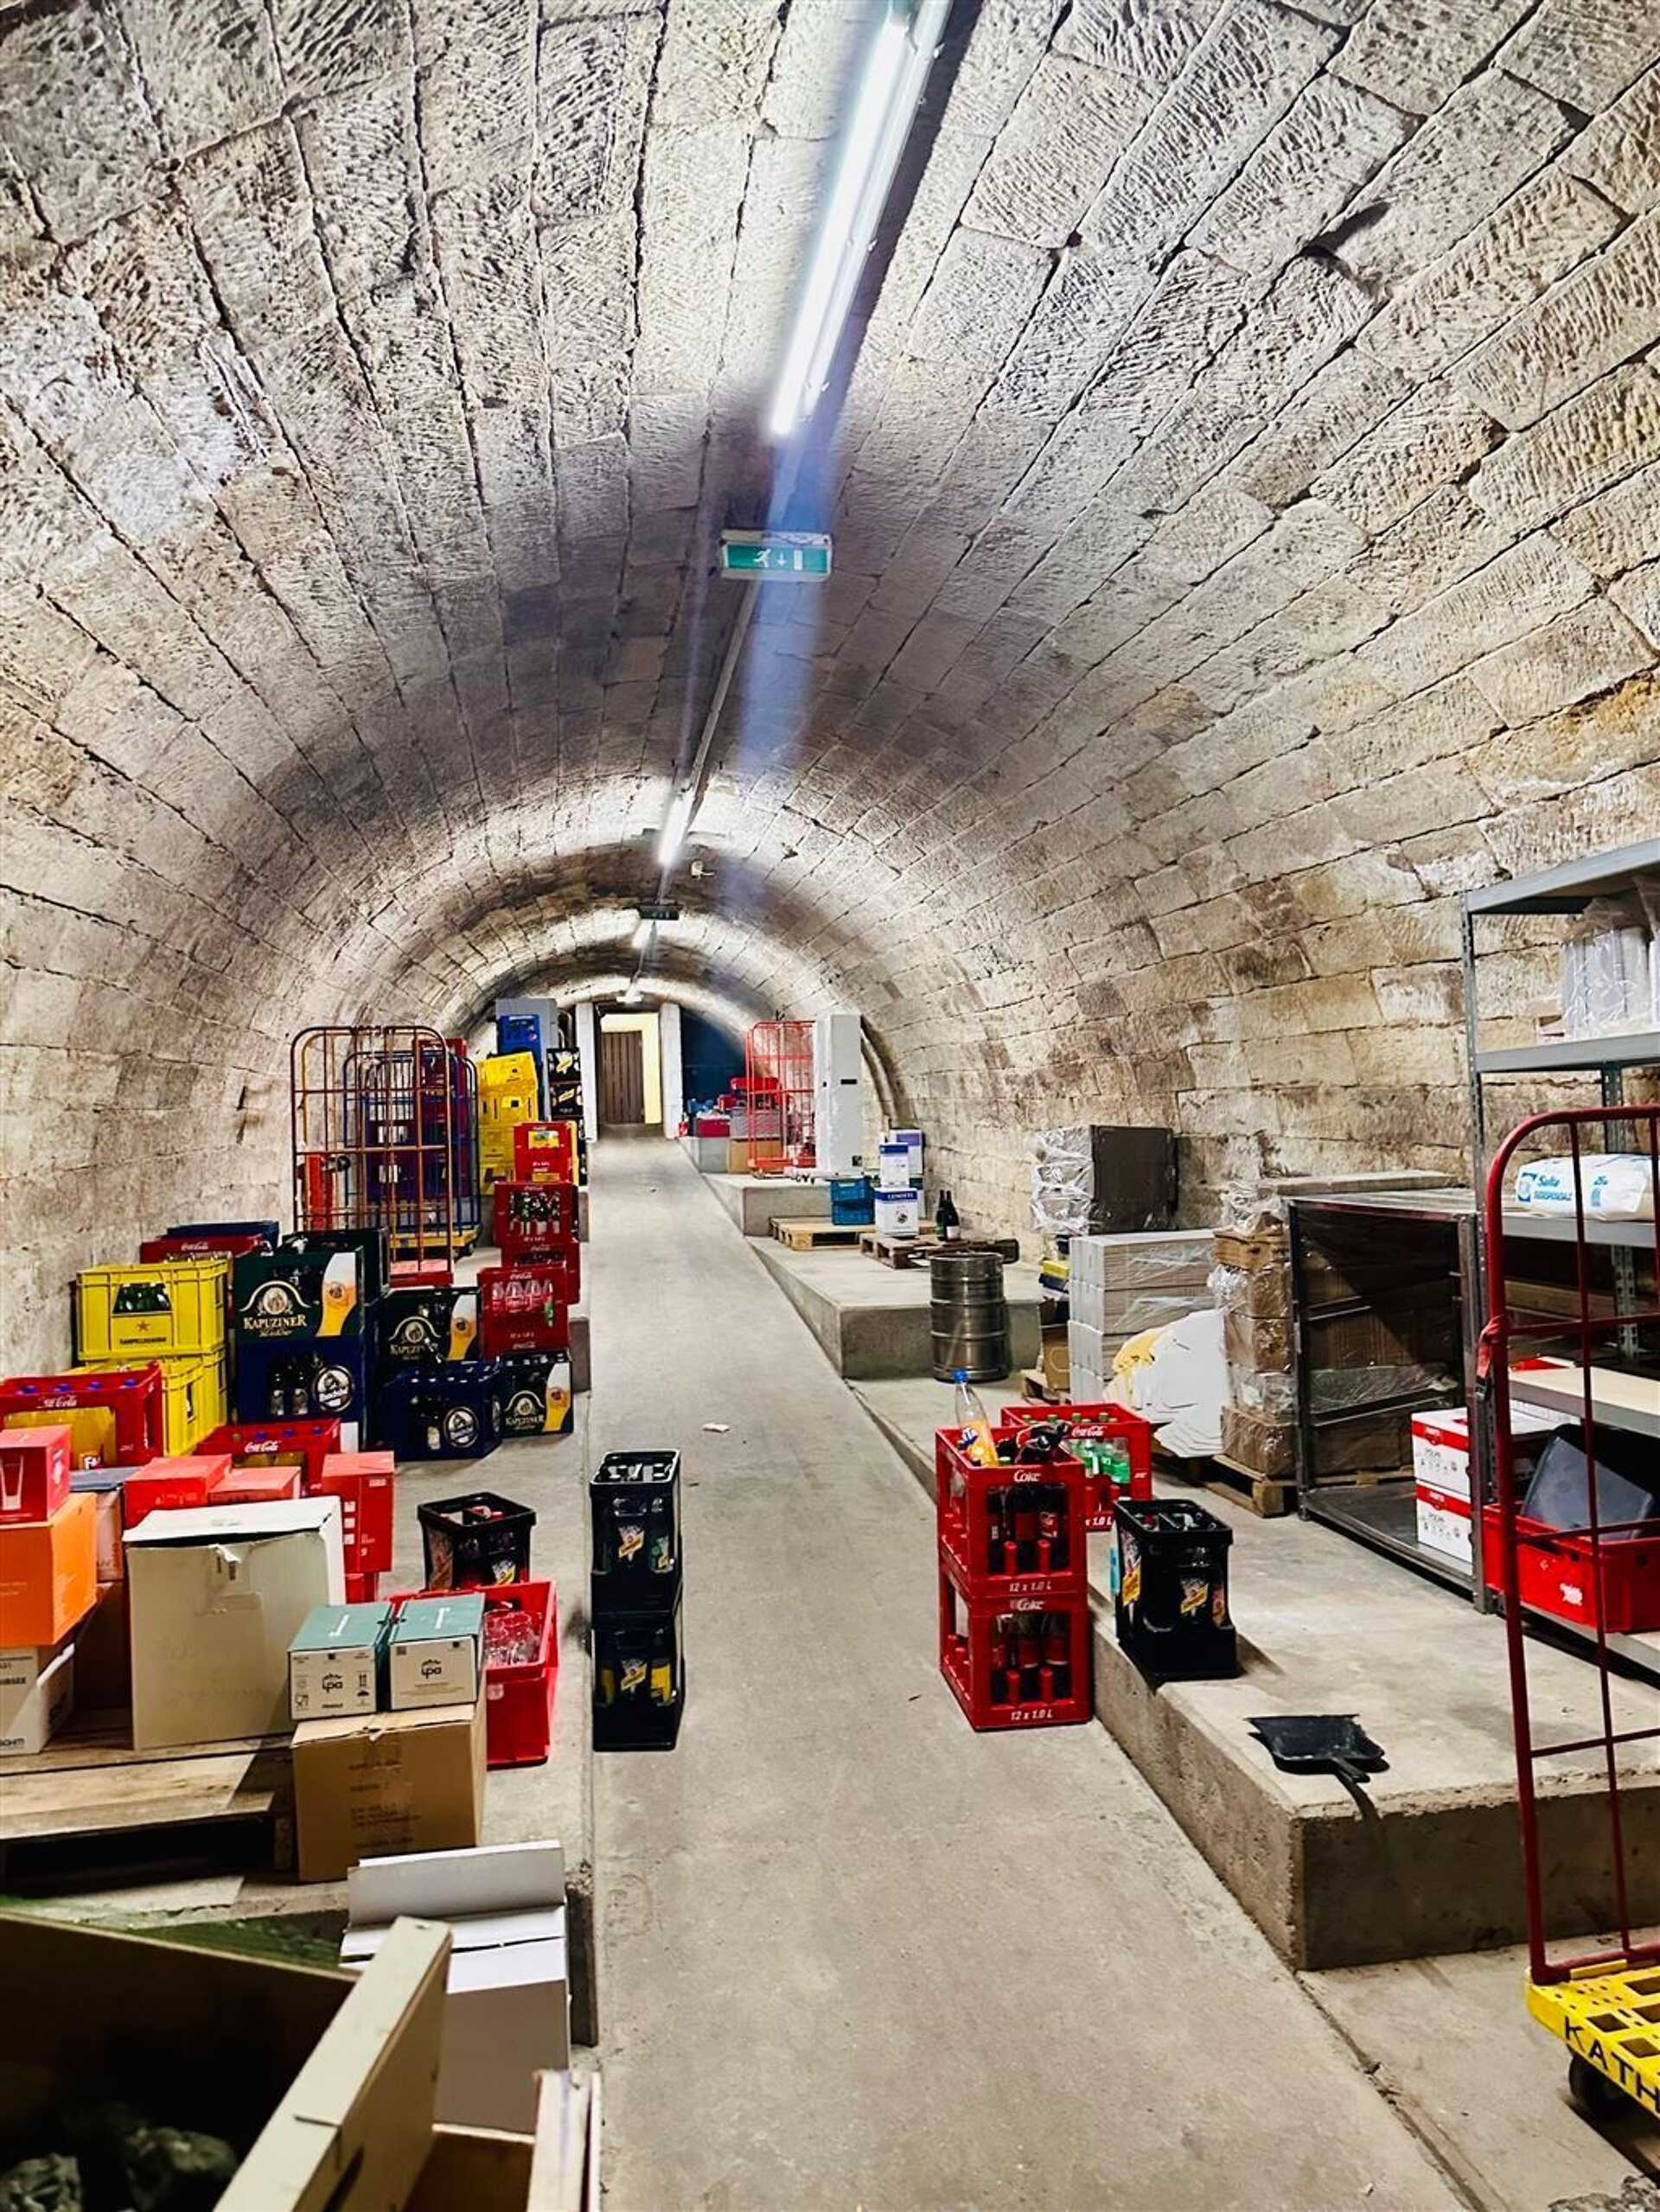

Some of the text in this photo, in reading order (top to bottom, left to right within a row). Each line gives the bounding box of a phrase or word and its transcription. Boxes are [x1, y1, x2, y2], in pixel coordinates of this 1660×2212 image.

[244, 1314, 308, 1329] KAPUZINER
[1013, 1469, 1042, 1482] Coke
[1009, 1583, 1020, 1592] 12
[1011, 1711, 1020, 1721] 12
